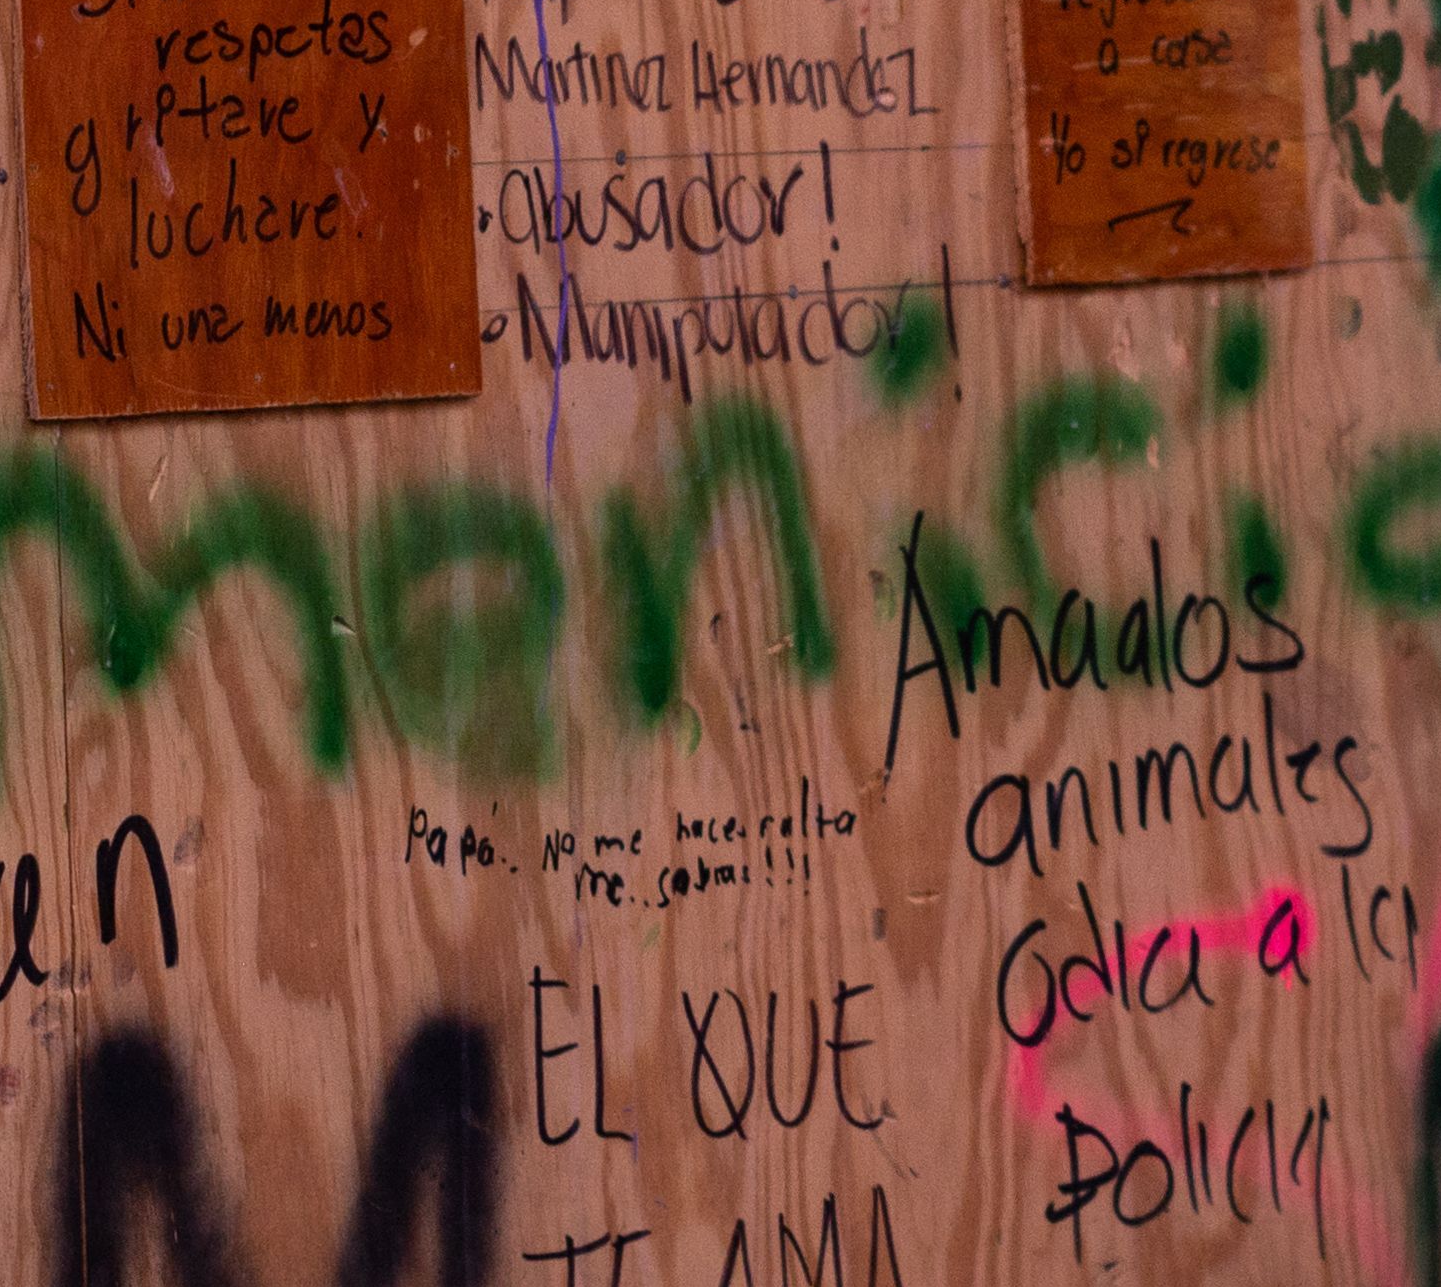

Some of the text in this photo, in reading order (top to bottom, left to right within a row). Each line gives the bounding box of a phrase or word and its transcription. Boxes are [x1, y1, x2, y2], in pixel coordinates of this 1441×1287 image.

[61, 75, 390, 218] gritare y
[72, 280, 398, 364] Ni una menos
[594, 827, 643, 858] me
[963, 690, 1376, 880] animales
[995, 880, 1216, 1050] odia
[1256, 898, 1310, 986] a
[528, 962, 890, 1150] EL QUE
